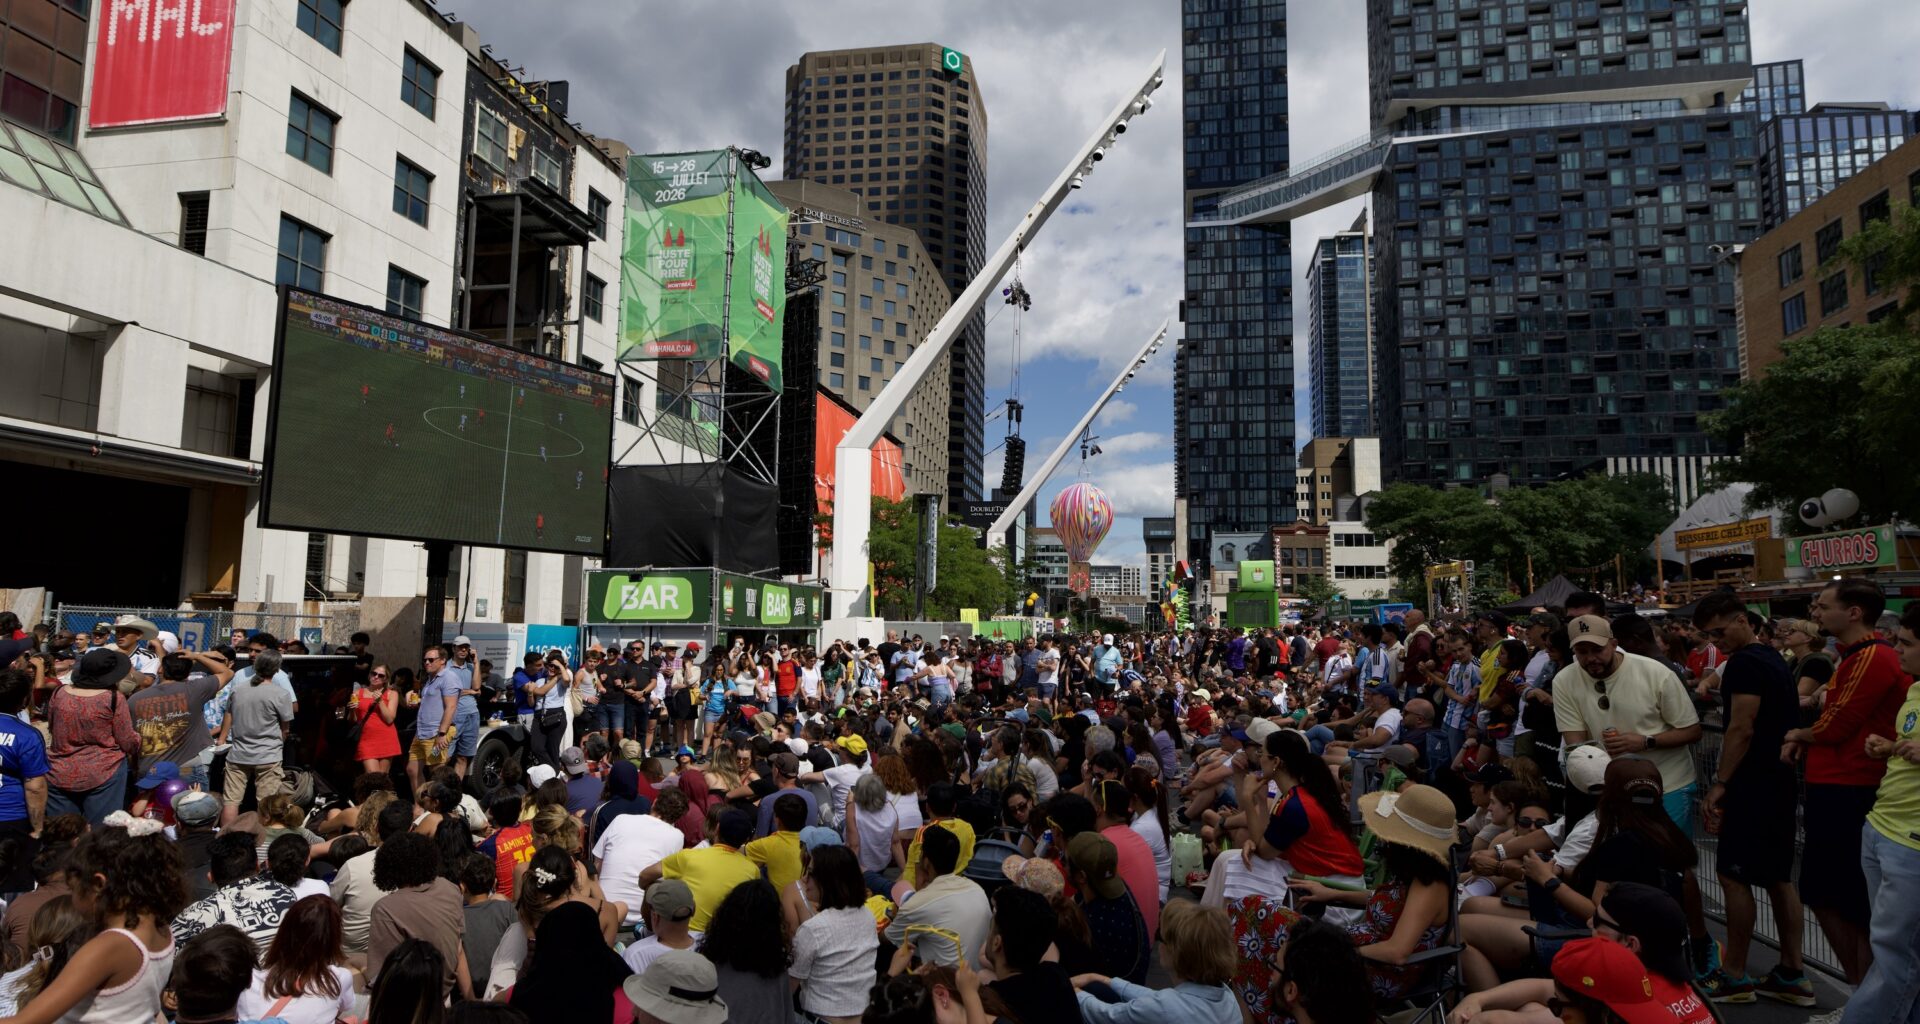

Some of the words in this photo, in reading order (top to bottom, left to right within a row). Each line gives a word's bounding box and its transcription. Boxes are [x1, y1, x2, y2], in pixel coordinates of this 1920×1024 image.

[669, 171, 710, 188] JUILLET
[655, 187, 686, 203] 2026
[656, 249, 691, 259] JUSTE
[658, 258, 689, 268] POUR
[660, 268, 686, 278] RIRE
[650, 344, 692, 353] HAHAHA.COM
[1720, 527, 1743, 539] CHEZ
[1745, 522, 1767, 536] STAN
[1801, 532, 1879, 568] CHURROS
[620, 584, 680, 610] BAR
[766, 592, 788, 617] BAR
[1579, 620, 1590, 632] LA
[497, 836, 526, 854] LAMINE
